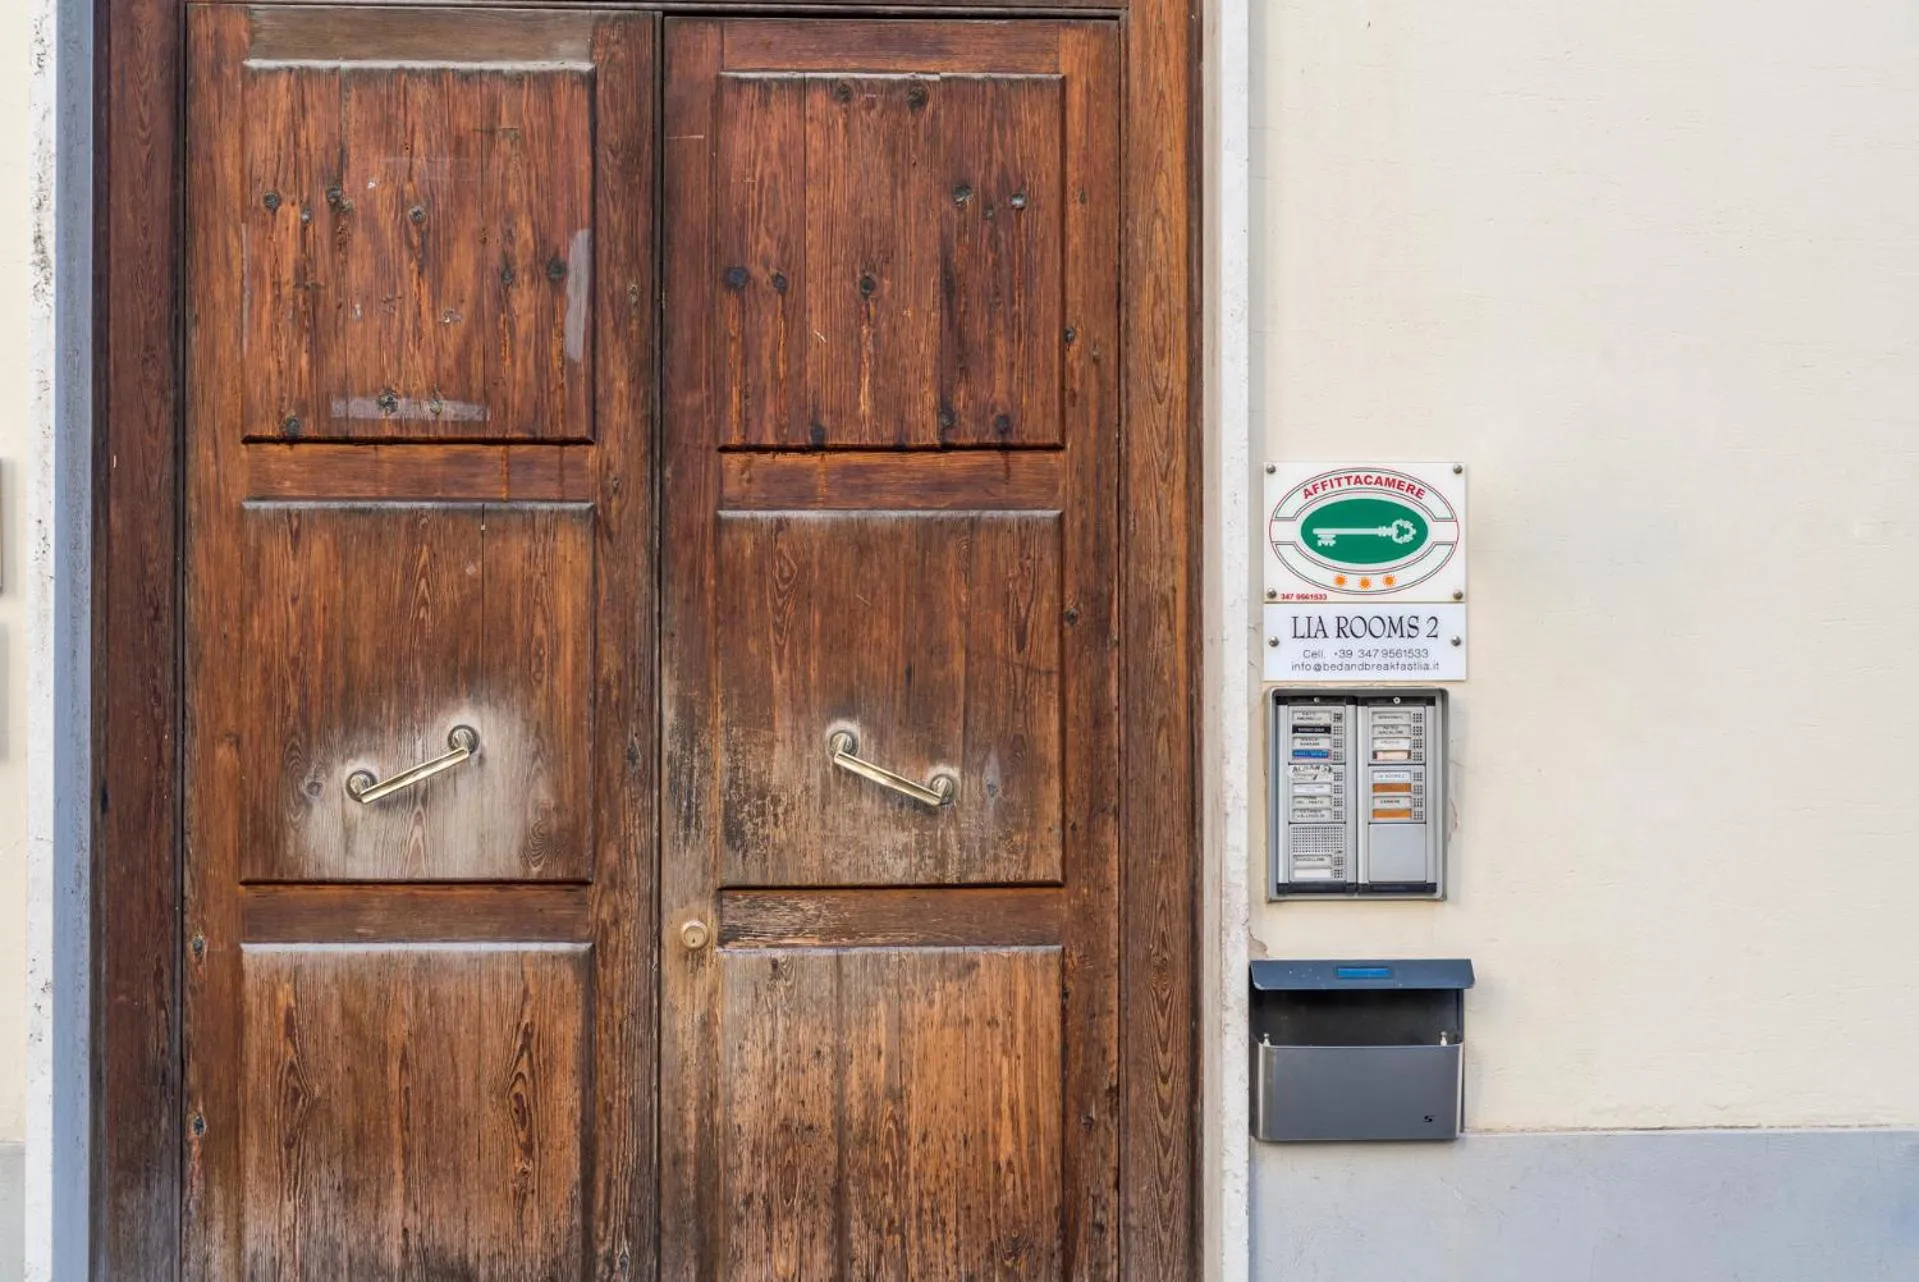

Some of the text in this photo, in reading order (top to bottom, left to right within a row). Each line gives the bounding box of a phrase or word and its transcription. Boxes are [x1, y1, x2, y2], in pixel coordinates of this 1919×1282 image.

[1302, 475, 1426, 500] AFFITTACAMERE
[1291, 616, 1439, 639] LIA ROOMS 2
[1291, 661, 1440, 672] info@bedandbreakfastlia.it
